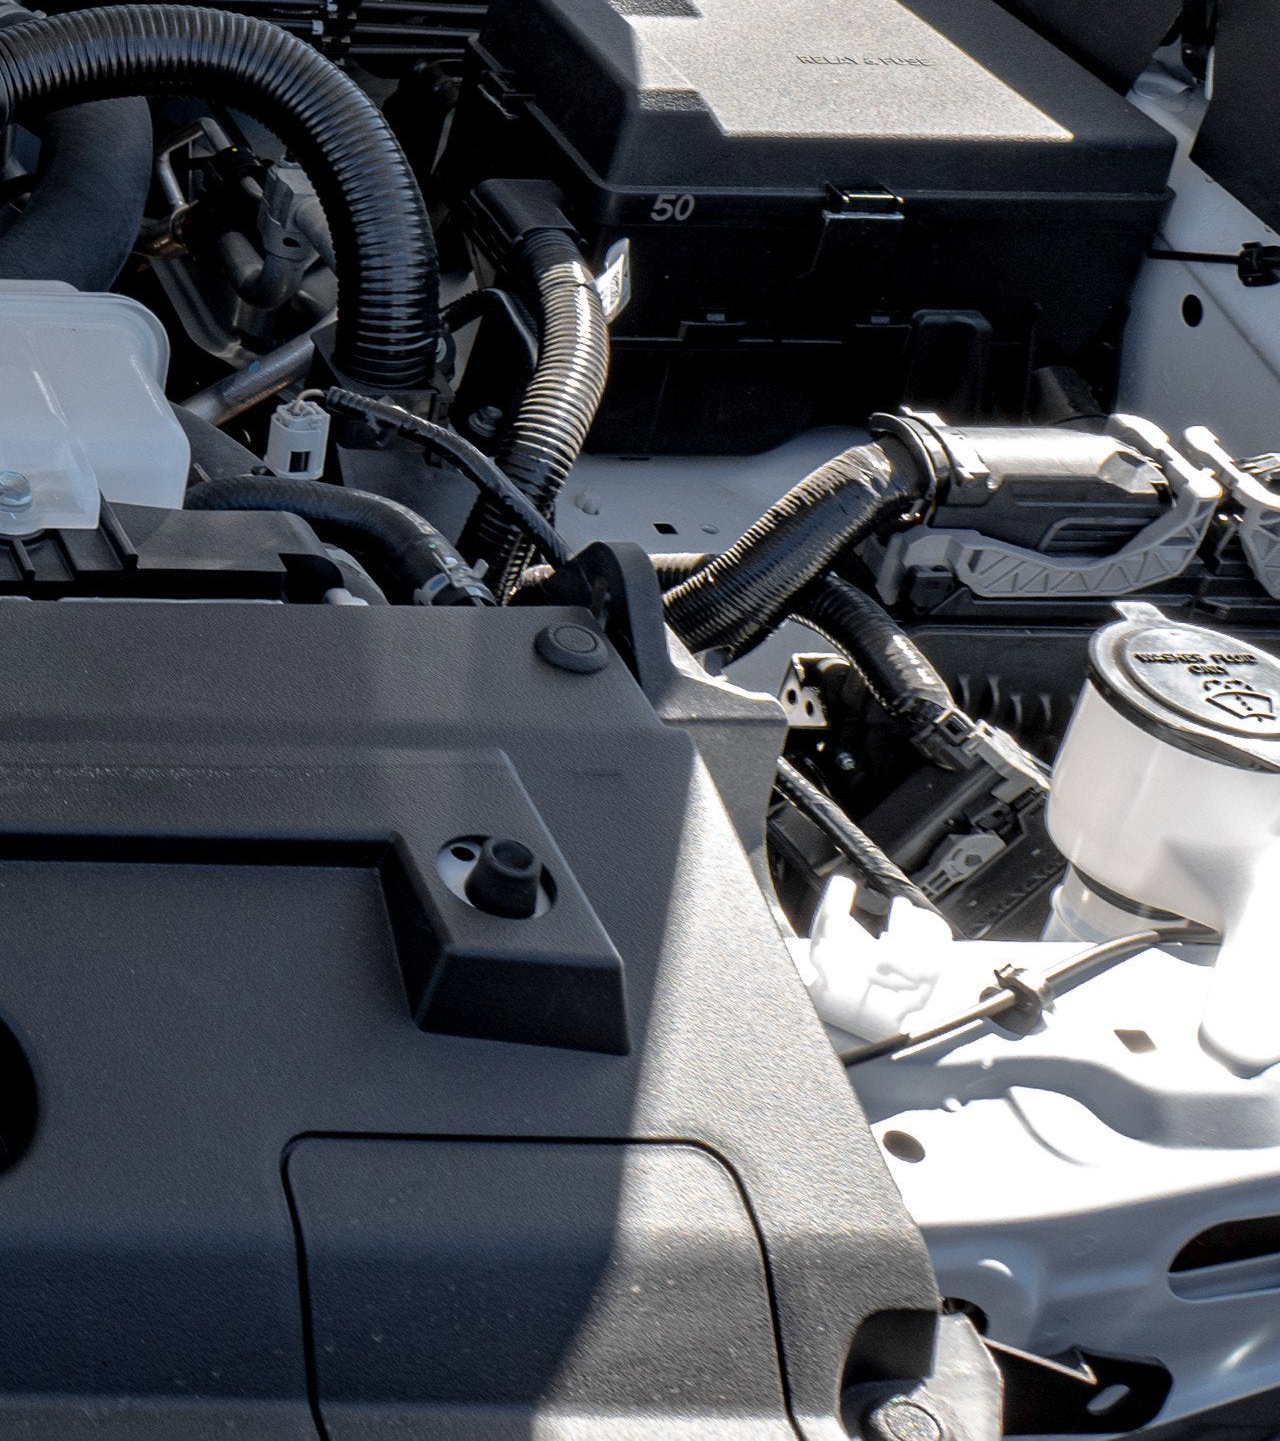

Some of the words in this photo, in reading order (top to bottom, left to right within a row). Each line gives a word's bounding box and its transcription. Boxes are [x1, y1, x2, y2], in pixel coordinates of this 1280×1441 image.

[796, 55, 858, 65] RELAY
[878, 56, 936, 67] FUSE
[650, 193, 696, 222] 50
[1134, 653, 1207, 664] WASHER
[1209, 653, 1258, 665] FLUID
[1188, 664, 1228, 676] ONLY
